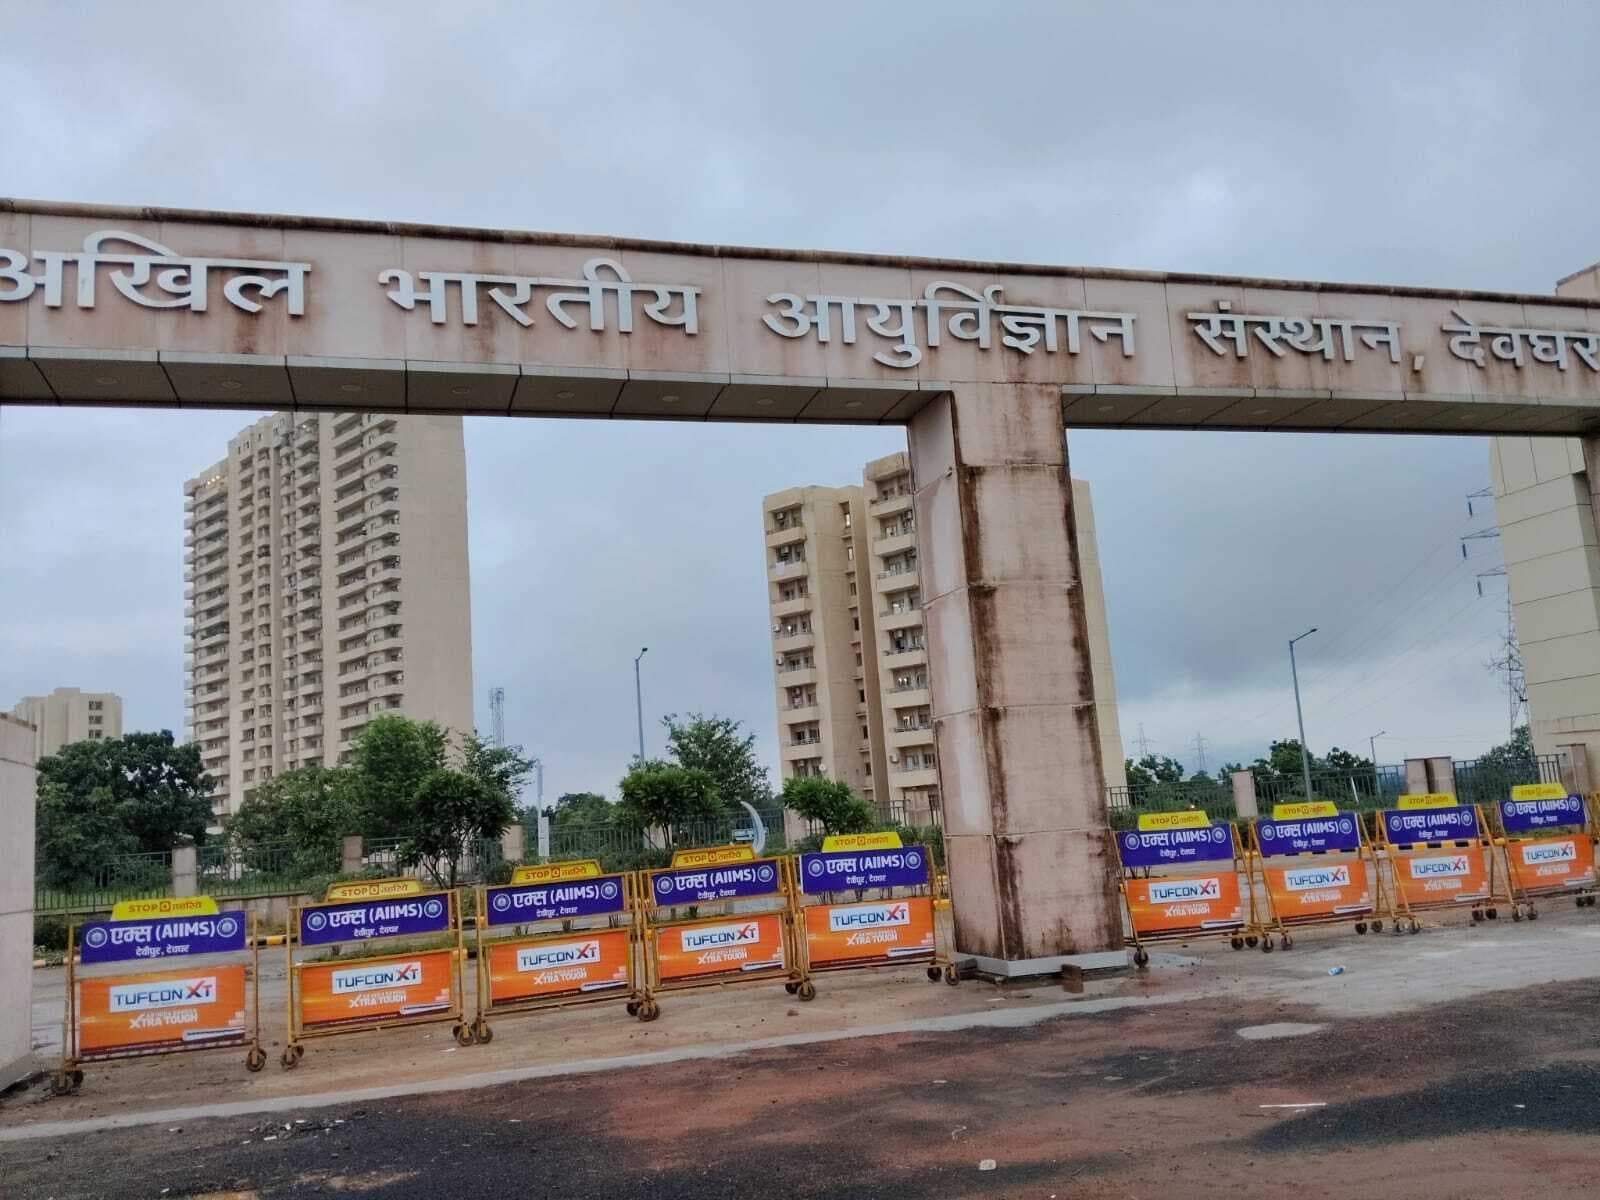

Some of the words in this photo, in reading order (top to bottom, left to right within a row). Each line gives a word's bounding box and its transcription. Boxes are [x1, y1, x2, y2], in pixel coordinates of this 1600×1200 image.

[0, 230, 311, 316] अखिल
[378, 258, 701, 335] भारतीय
[762, 281, 1138, 369] आयुर्विज्ञान
[1440, 309, 1600, 372] देवघर
[1140, 833, 1169, 848] एम्स
[1171, 830, 1211, 846] (AIIMS)
[1303, 821, 1339, 836] (AIIMS)
[683, 855, 707, 864] STOP
[825, 858, 857, 874] एम्स
[859, 855, 905, 872] (AIIMS)
[525, 870, 549, 880] STOP
[674, 874, 708, 890] एम्स
[710, 868, 757, 887] (AIIMS)
[1288, 874, 1330, 886] TUFCON
[341, 887, 368, 897] STOP
[512, 891, 548, 908] एम्स
[551, 885, 599, 905] (AIIMS)
[1152, 886, 1198, 899] TUFCON
[128, 902, 157, 912] STOP
[328, 908, 366, 928] एम्स
[369, 903, 423, 924] (AIIMS)
[833, 912, 885, 926] TUFCON
[886, 905, 906, 921] XT
[110, 926, 152, 944] एम्स
[155, 921, 216, 941] (AIIMS)
[685, 931, 735, 947] TUFCON
[737, 925, 757, 940] XT
[521, 952, 574, 967] TUFCON
[577, 944, 597, 959] XT
[336, 973, 393, 988] TUFCON
[396, 965, 419, 981] XT
[114, 988, 183, 1006] TUFCON
[186, 980, 212, 999] XT
